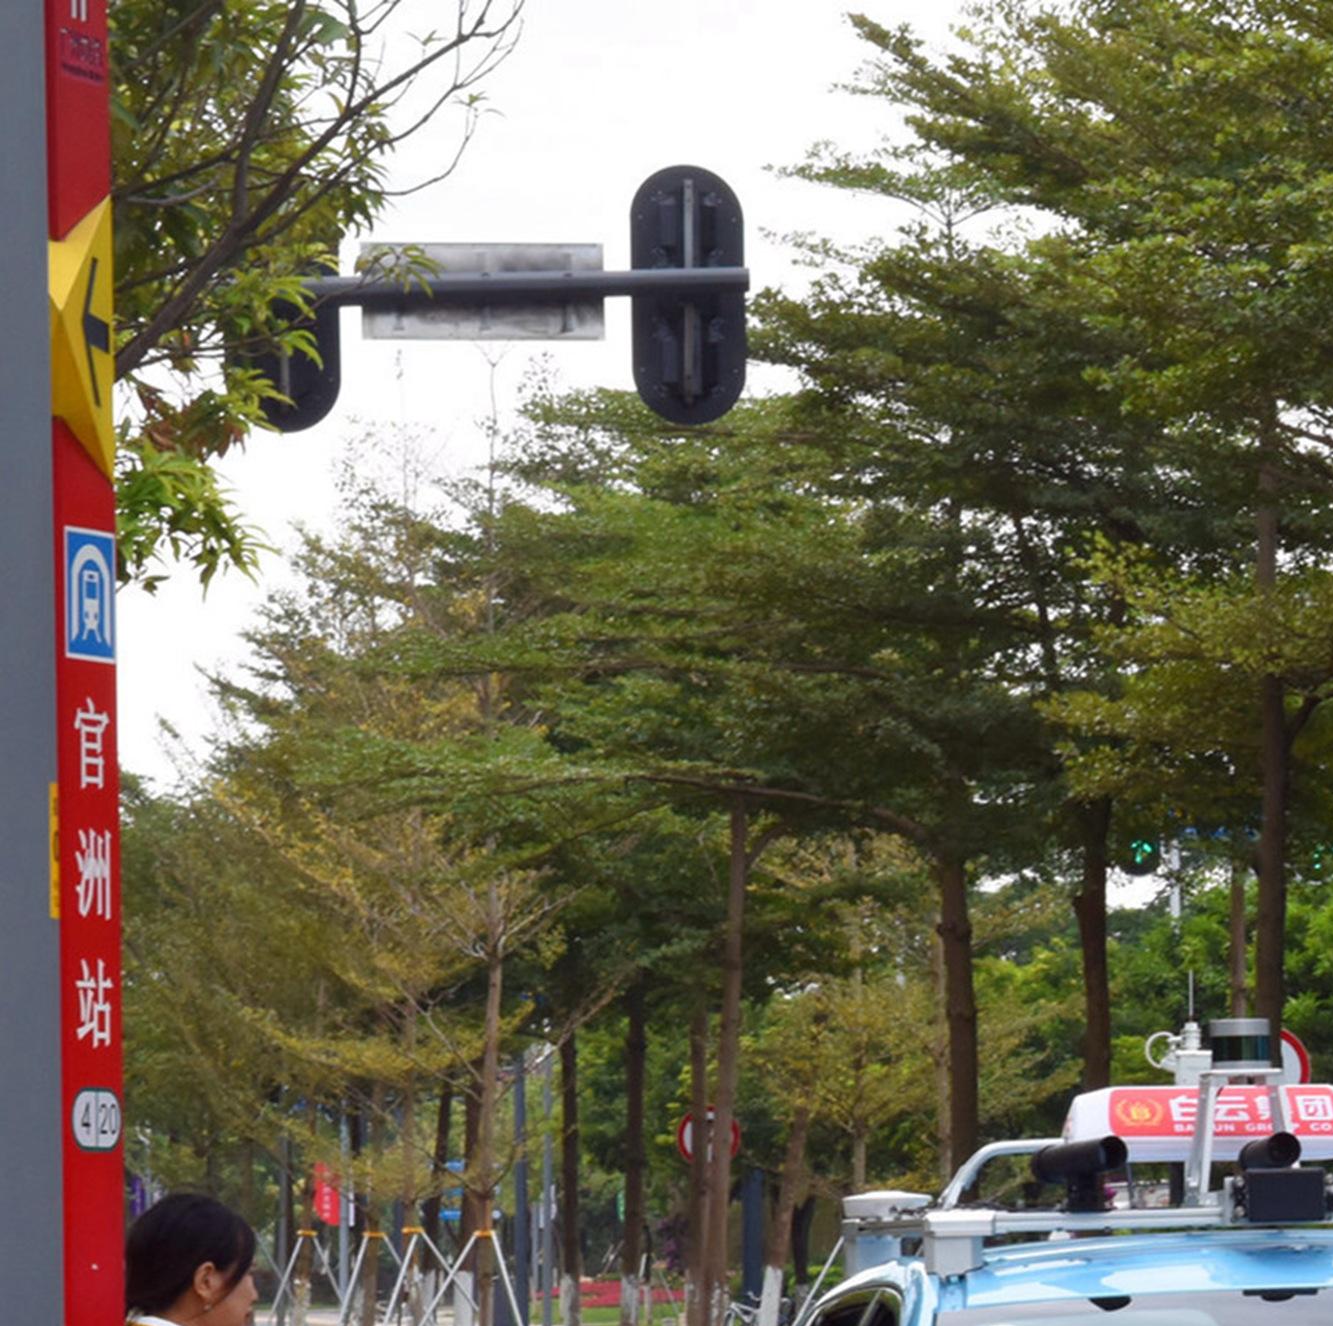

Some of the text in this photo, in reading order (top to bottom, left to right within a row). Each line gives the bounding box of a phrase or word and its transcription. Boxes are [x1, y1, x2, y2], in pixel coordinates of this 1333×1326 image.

[73, 697, 113, 1048] 官洲站
[1174, 1123, 1235, 1132] BAUN
